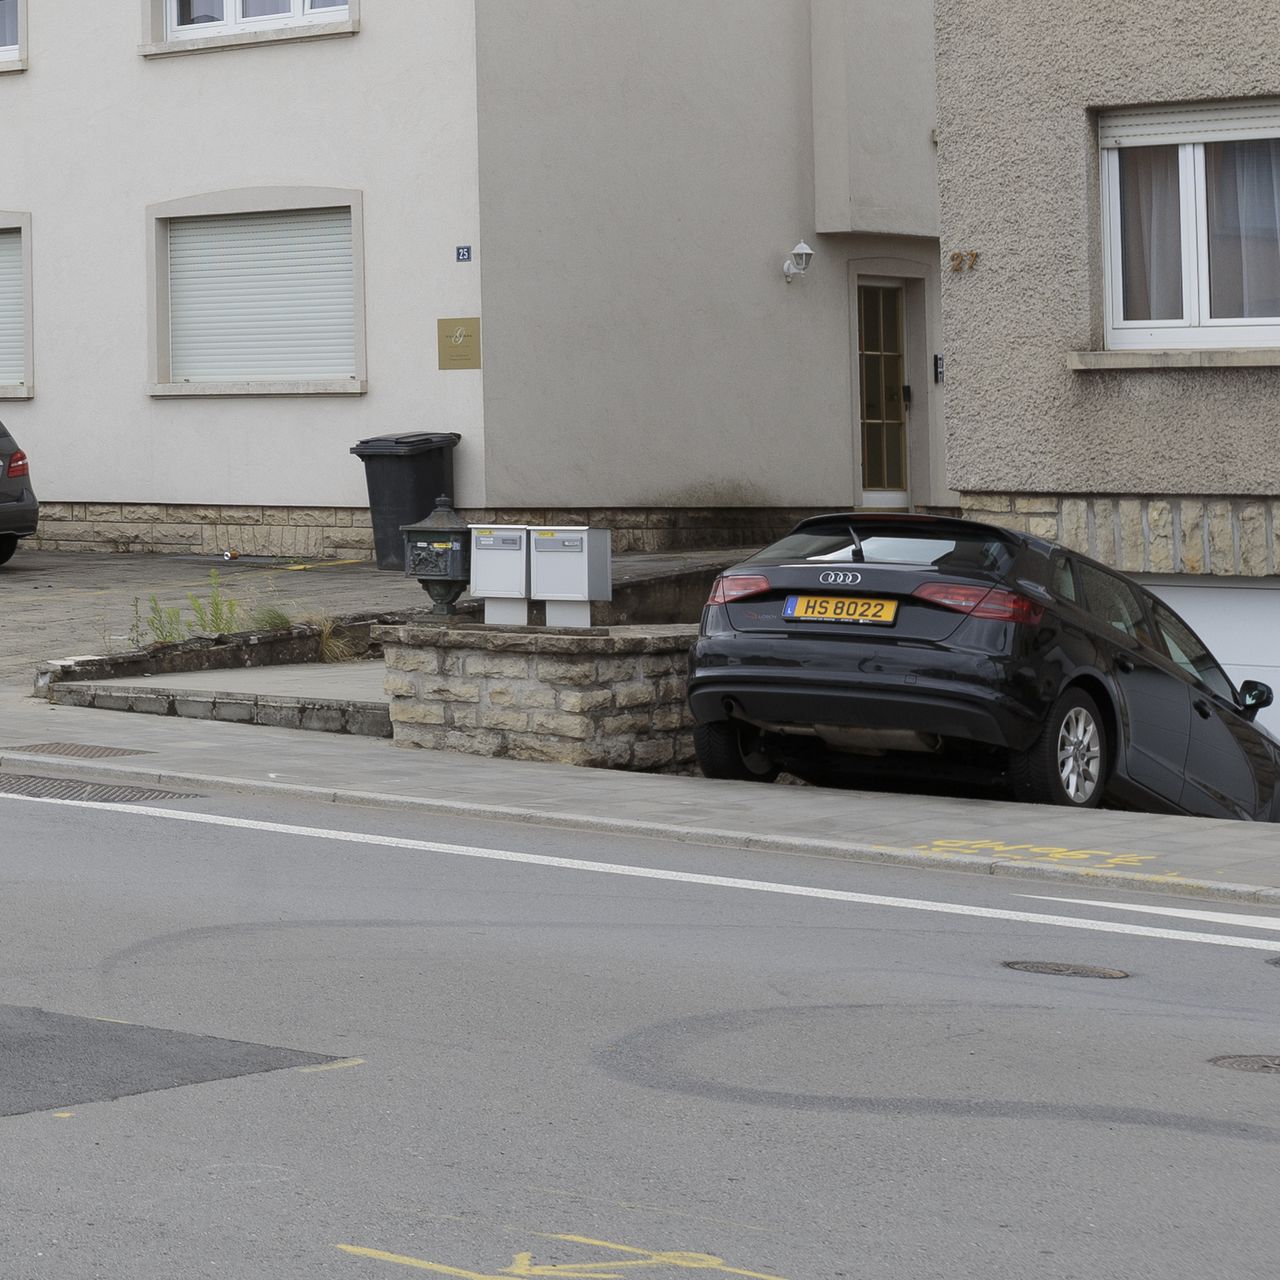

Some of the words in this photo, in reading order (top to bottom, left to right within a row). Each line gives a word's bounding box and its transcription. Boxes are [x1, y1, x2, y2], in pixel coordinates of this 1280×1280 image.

[459, 248, 469, 259] 25
[950, 251, 977, 272] 27
[804, 600, 830, 615] HS
[833, 601, 885, 618] 8022
